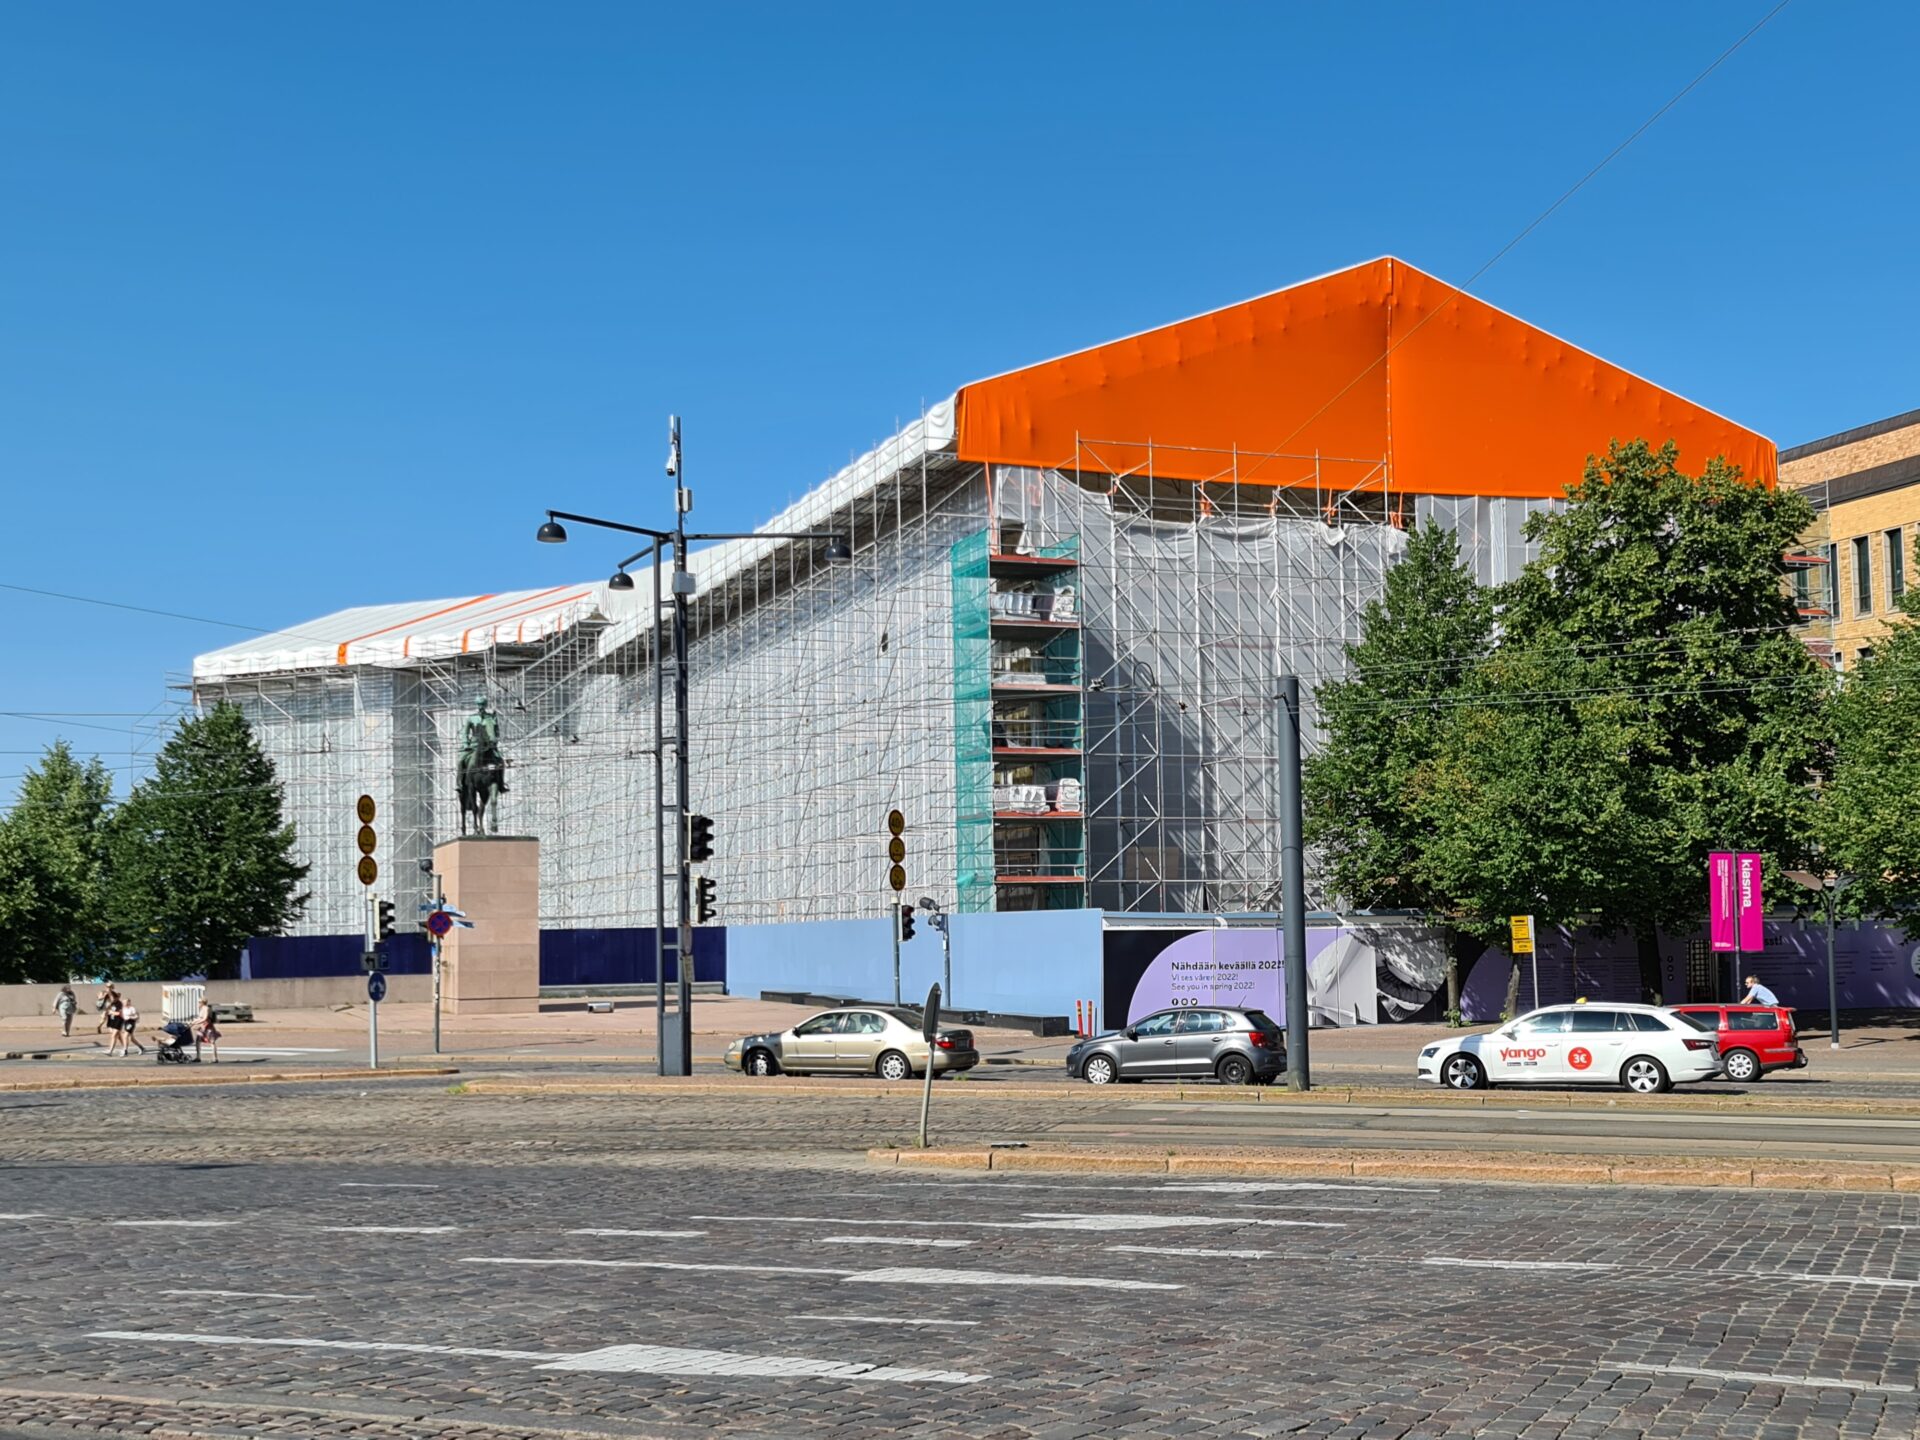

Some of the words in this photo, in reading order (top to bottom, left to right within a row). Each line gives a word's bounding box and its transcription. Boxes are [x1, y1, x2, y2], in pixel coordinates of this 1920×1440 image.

[1171, 961, 1217, 971] Nähdään
[1219, 960, 1256, 970] keväällä
[1258, 960, 1285, 970] 2022!
[1171, 973, 1180, 981] Vi
[1217, 973, 1239, 981] 2022!
[1171, 983, 1186, 991] See
[1187, 984, 1200, 992] you
[1201, 982, 1209, 991] in
[1210, 982, 1233, 991] spring
[1233, 982, 1255, 990] 2022!
